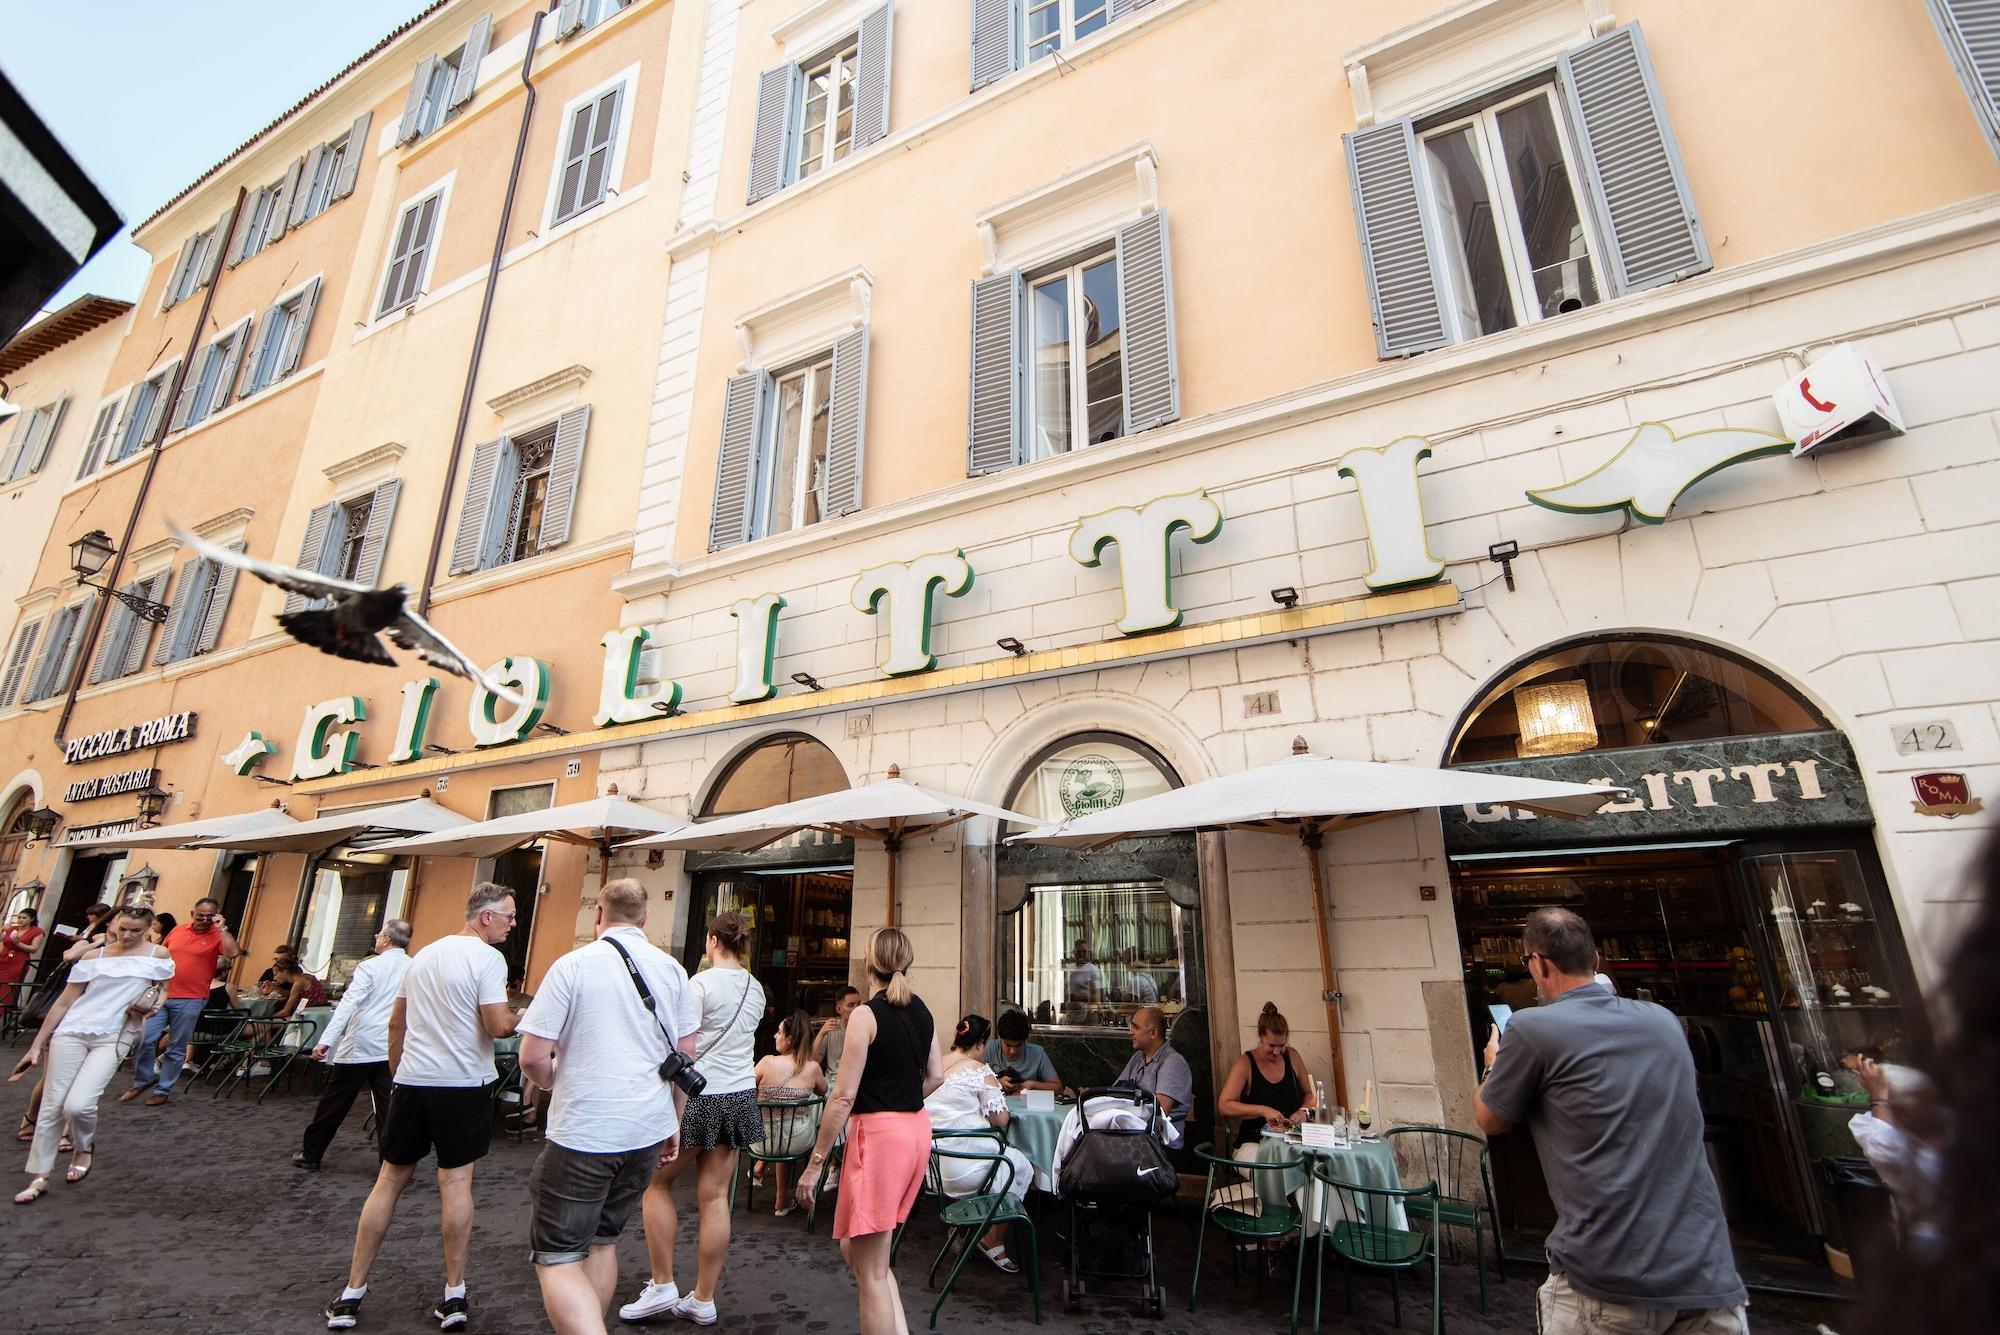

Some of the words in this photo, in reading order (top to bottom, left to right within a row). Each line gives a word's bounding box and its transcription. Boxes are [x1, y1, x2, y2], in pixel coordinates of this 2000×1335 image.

[289, 434, 1446, 782] GIOLITTI
[1250, 694, 1274, 714] 41
[63, 726, 134, 764] PICCOLA
[136, 710, 191, 748] ROMA
[1901, 724, 1953, 751] 42
[64, 778, 100, 802] ANTICA
[99, 767, 153, 796] HOSTARIA
[1919, 779, 1962, 804] ROMA
